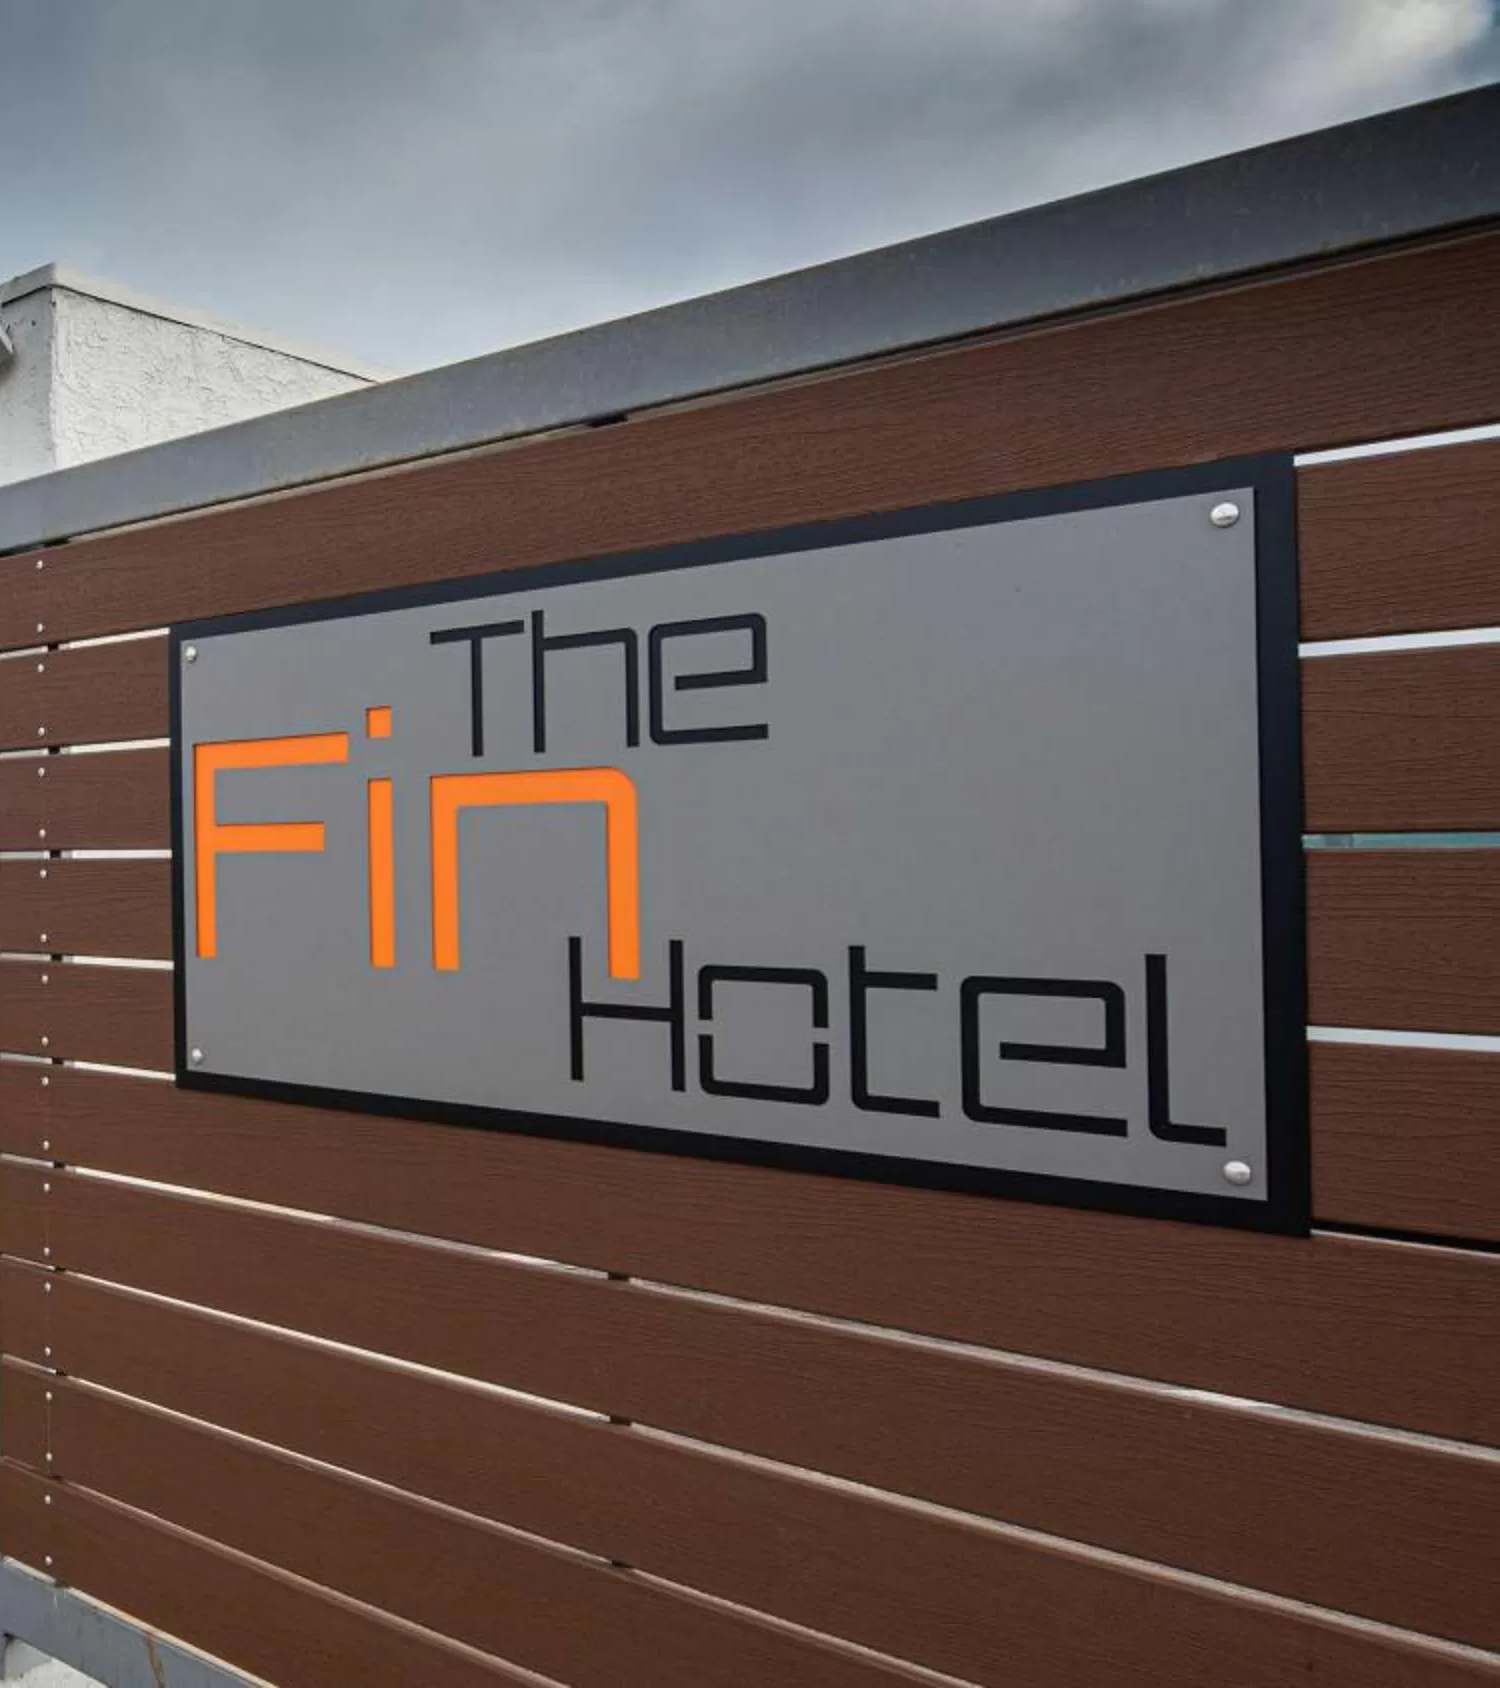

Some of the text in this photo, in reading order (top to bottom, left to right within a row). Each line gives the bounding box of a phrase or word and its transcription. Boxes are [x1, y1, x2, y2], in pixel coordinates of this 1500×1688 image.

[430, 610, 769, 757] The
[194, 706, 639, 980] Fin
[568, 936, 1227, 1147] Hotel
